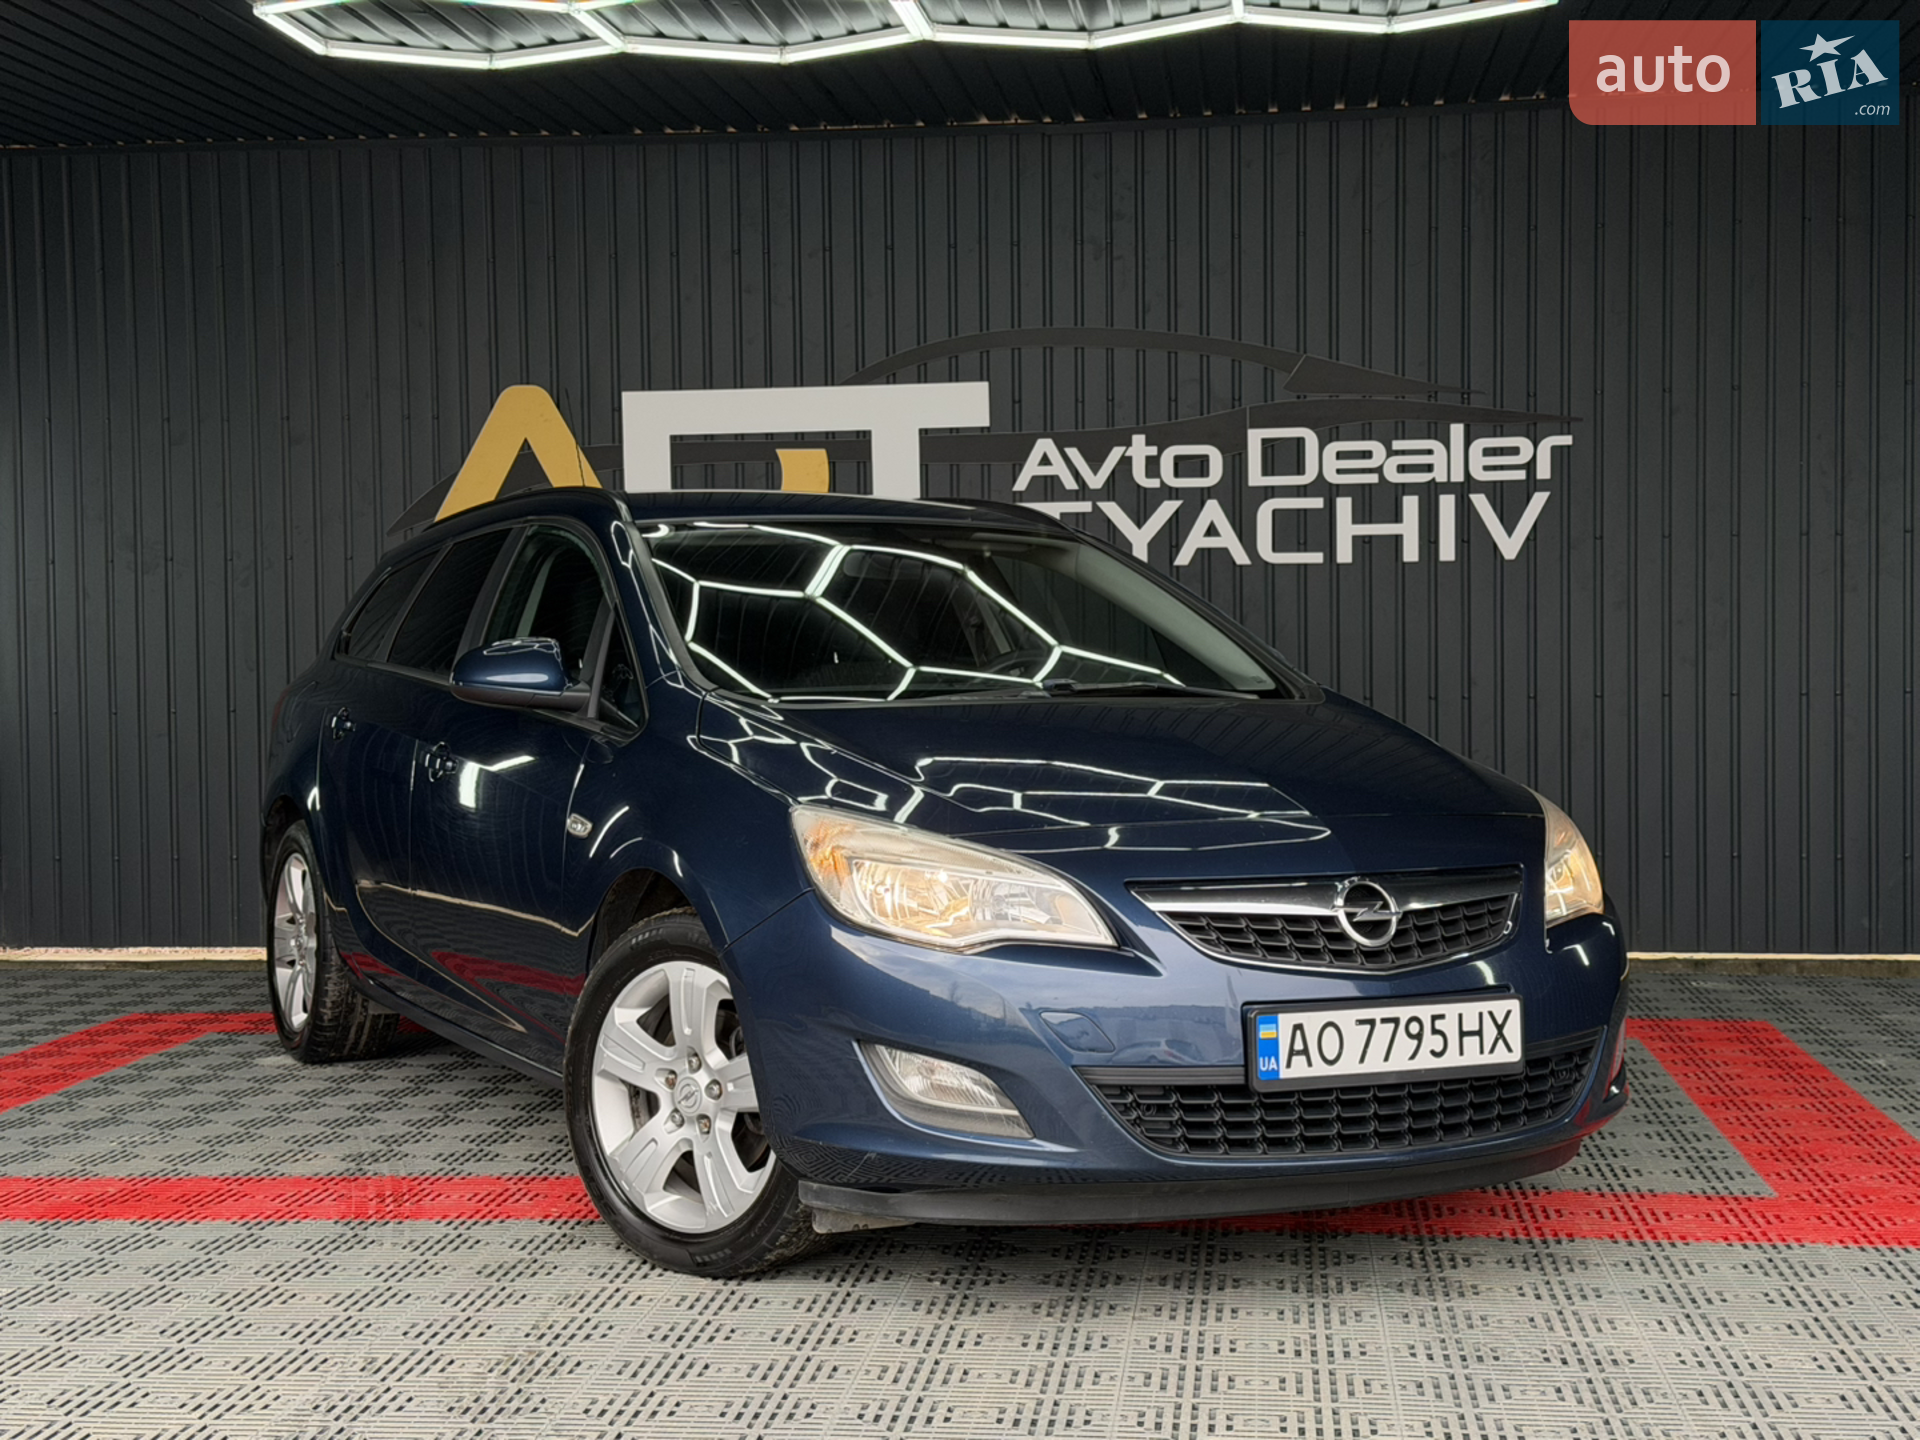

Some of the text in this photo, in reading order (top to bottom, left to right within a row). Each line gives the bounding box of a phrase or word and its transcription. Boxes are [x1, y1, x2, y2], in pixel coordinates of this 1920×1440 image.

[1012, 423, 1573, 491] Avto Dealer
[1260, 1056, 1278, 1072] UA
[1285, 1009, 1514, 1069] AO 7795 HX
